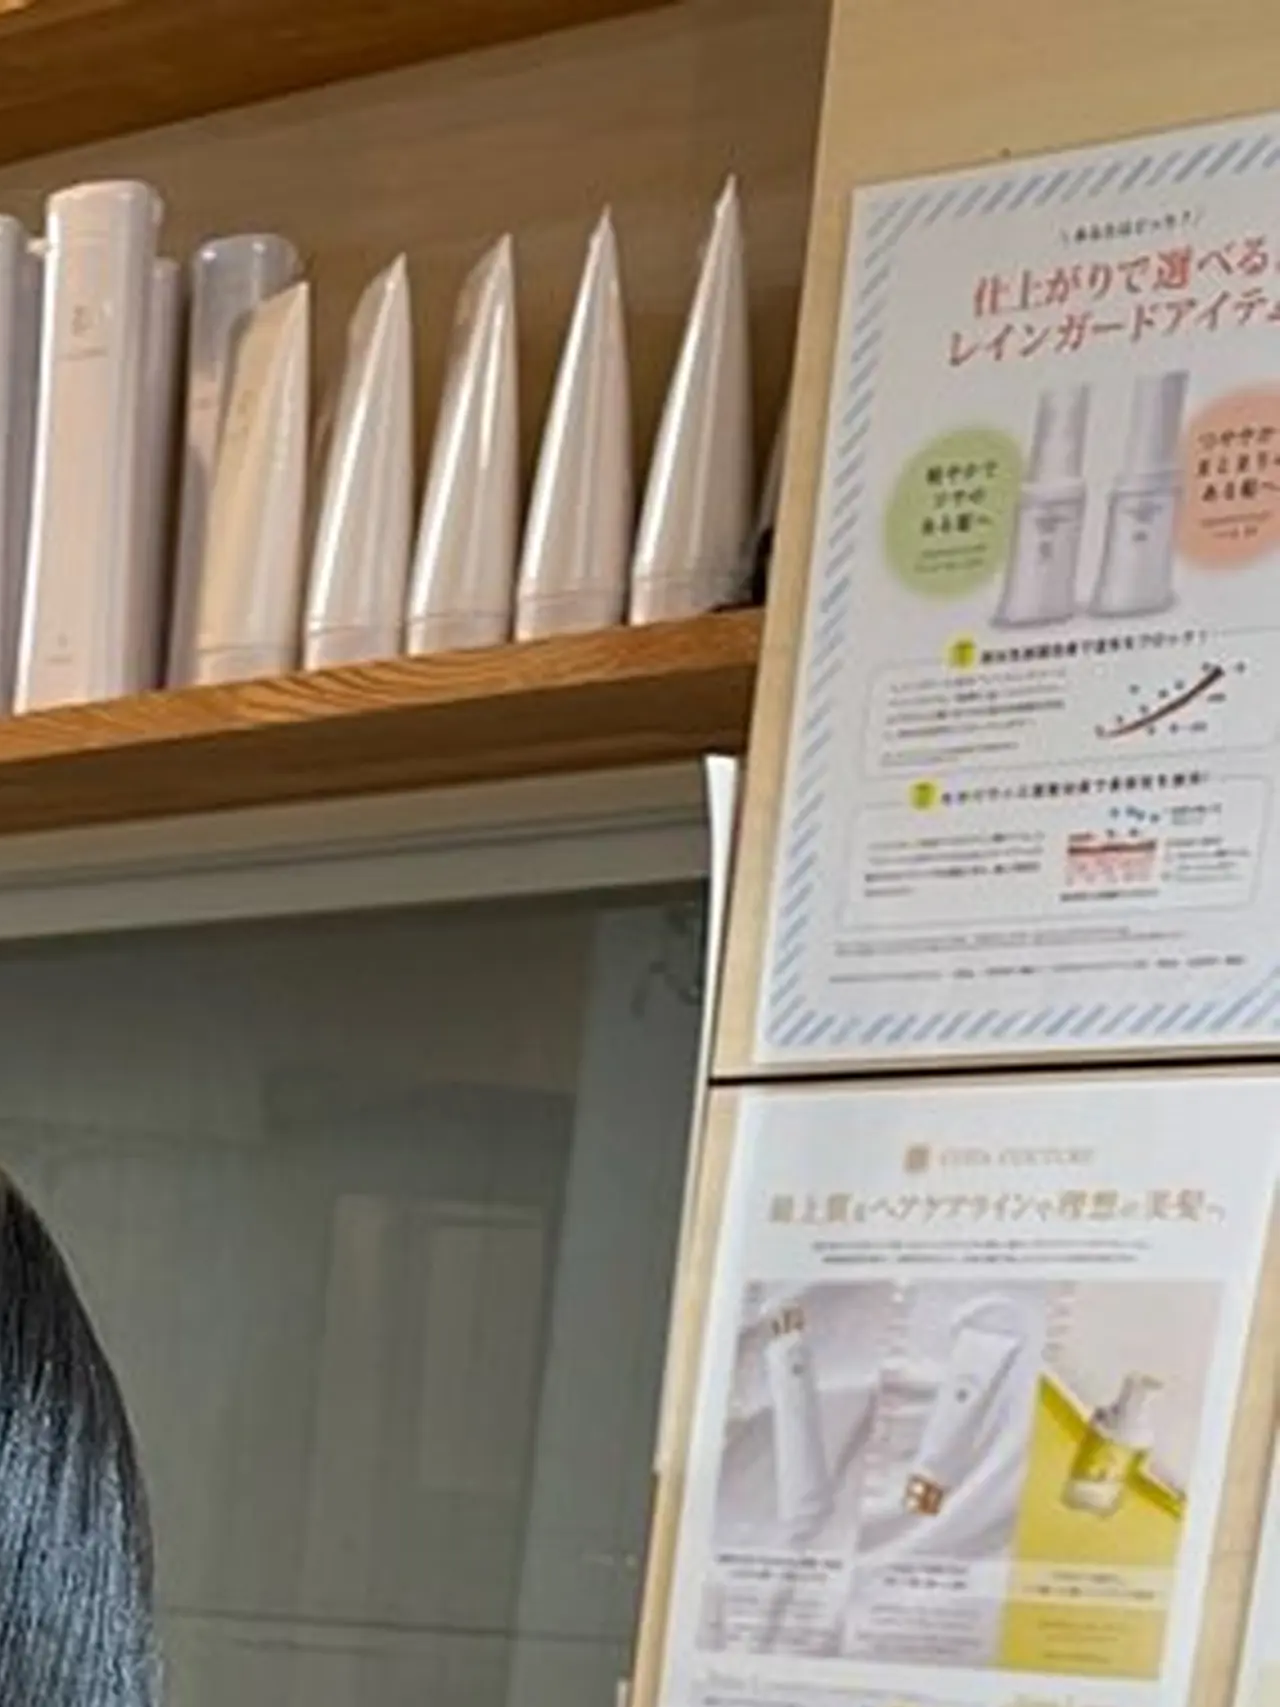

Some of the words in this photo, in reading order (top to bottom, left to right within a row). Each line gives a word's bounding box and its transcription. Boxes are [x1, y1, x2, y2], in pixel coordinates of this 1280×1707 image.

[973, 236, 1280, 318] 仕上がりで選べる
